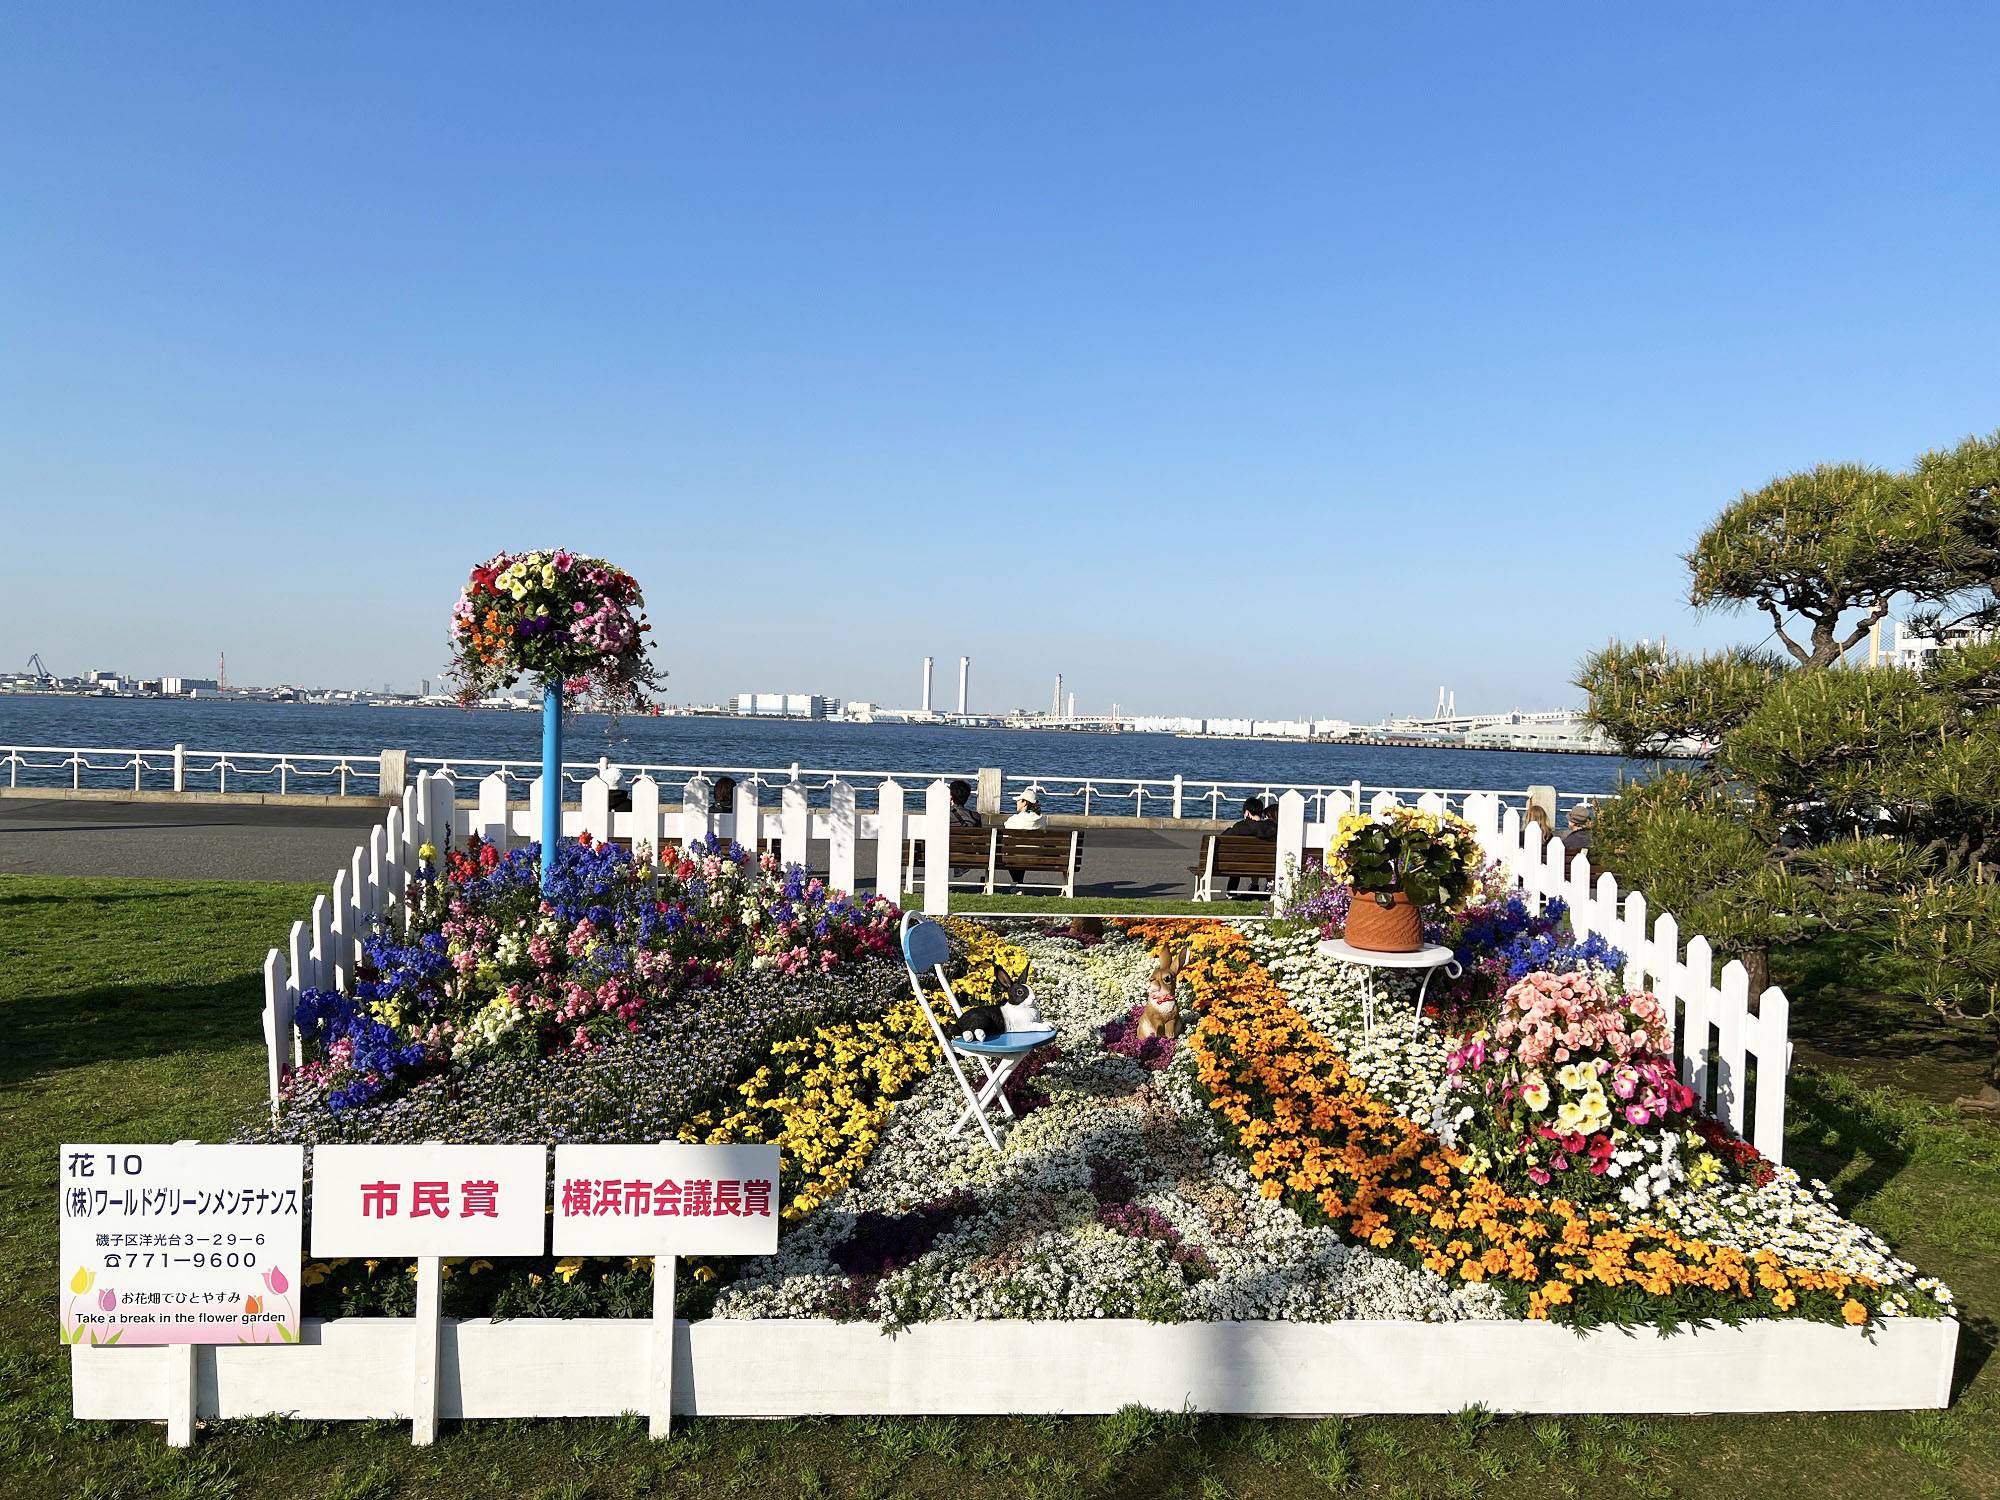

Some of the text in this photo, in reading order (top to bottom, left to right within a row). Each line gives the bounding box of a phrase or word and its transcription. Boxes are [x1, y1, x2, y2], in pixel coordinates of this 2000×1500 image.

[68, 1152, 142, 1178] 花 10
[66, 1187, 298, 1218] (株)ワールドグリーンメンテナンス
[360, 1180, 500, 1219] 市民賞
[561, 1177, 772, 1218] 横浜市会議長賞
[121, 1291, 241, 1305] お花畑でひとやすみ
[75, 1312, 286, 1325] Take a break in the flower garden
